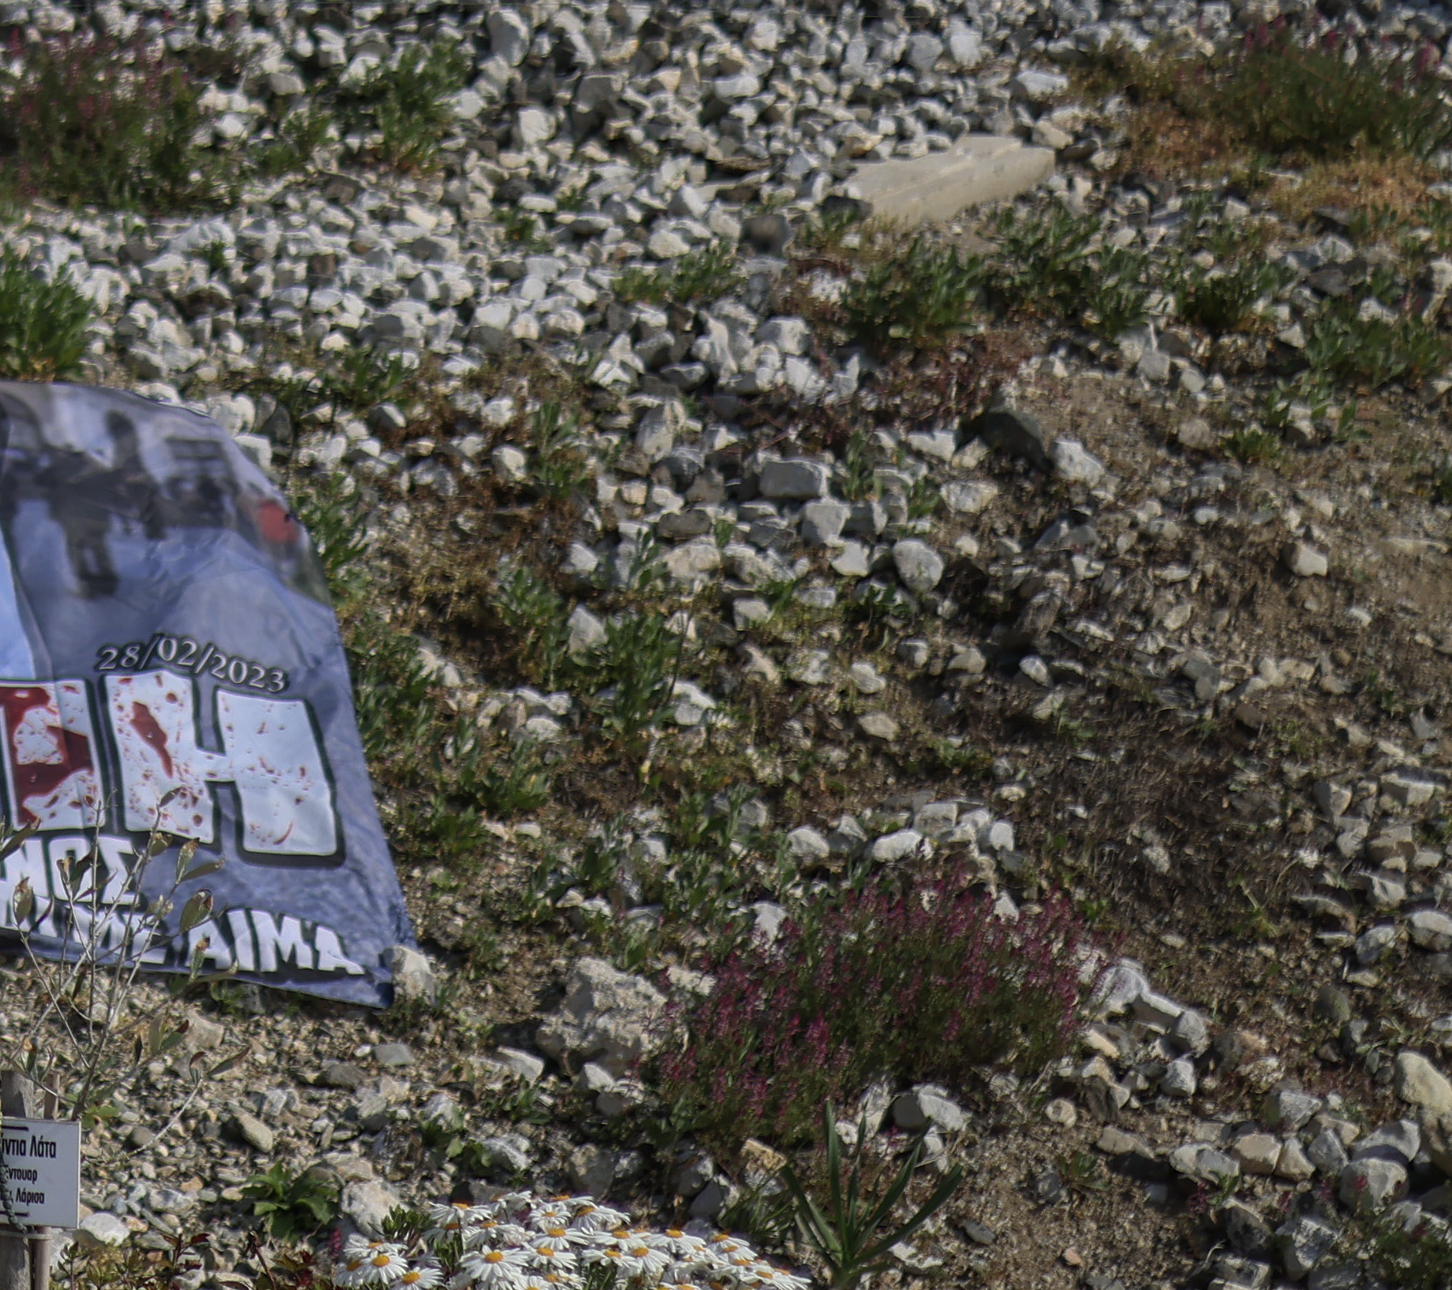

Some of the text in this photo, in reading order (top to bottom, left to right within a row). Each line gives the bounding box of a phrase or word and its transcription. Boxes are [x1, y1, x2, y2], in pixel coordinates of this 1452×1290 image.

[99, 635, 287, 693] 28/02/2023
[29, 1135, 57, 1158] Λάτα
[16, 1187, 46, 1206] Λάρισα
